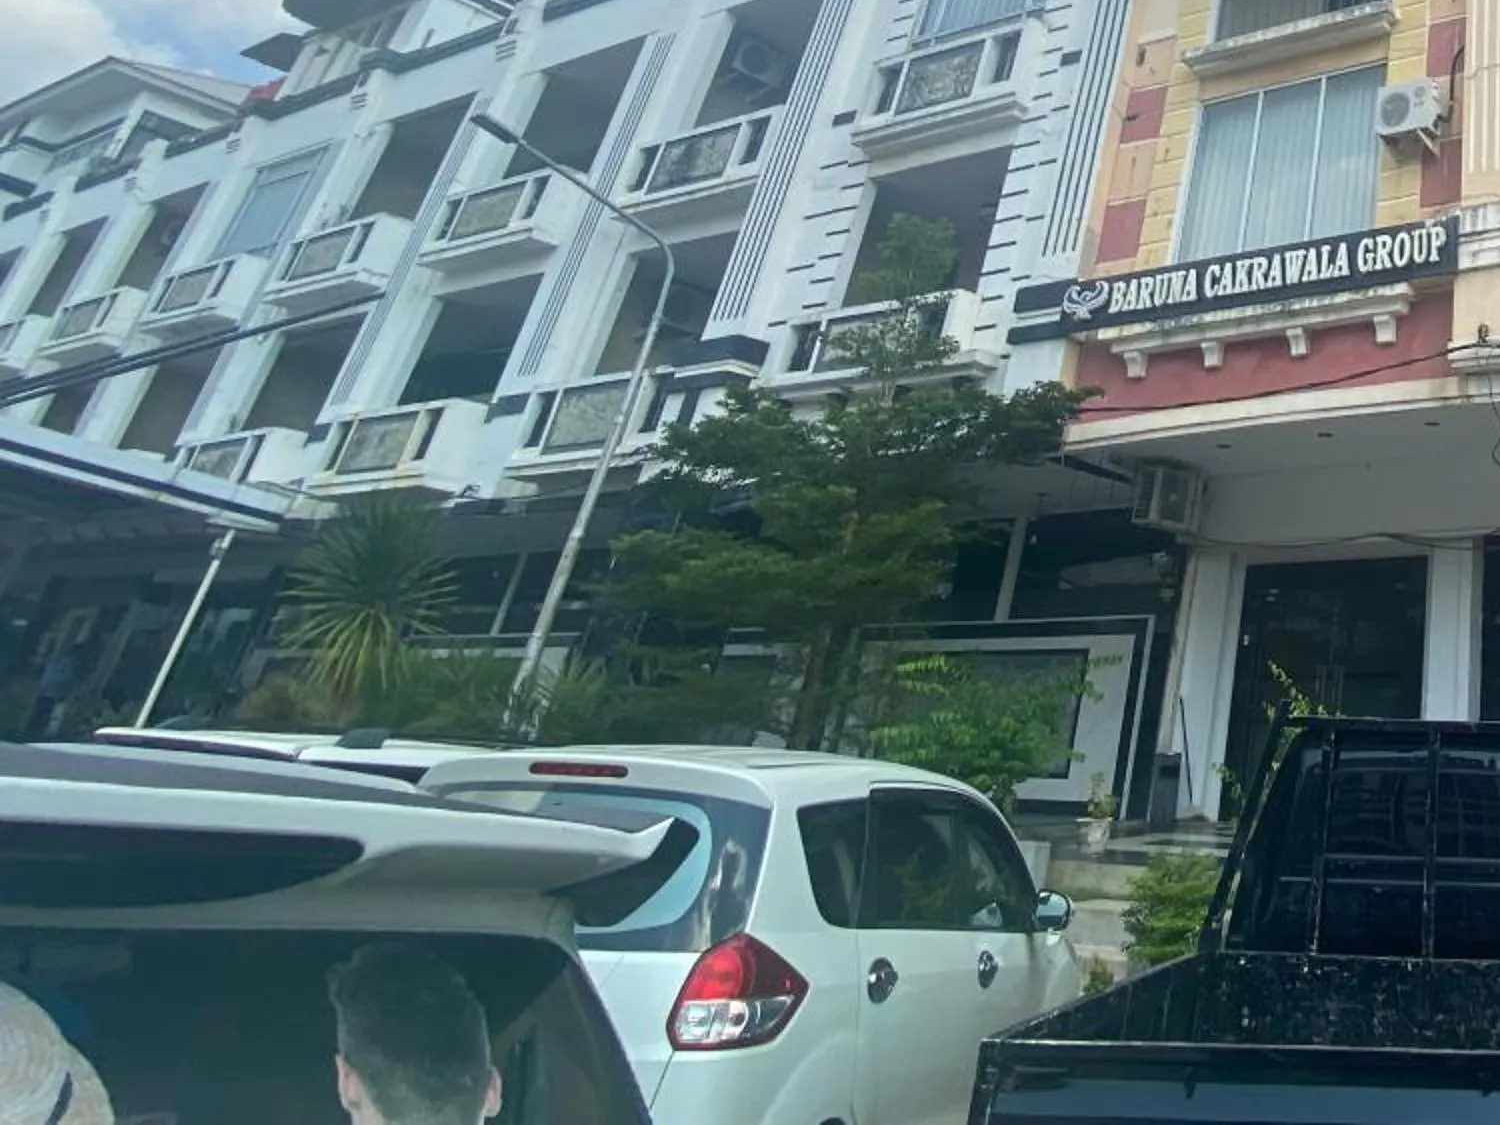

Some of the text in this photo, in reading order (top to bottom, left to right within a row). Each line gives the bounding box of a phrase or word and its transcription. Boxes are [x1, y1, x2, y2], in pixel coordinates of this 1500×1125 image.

[1108, 225, 1447, 314] BARUNA CAKRAWALA GROUP
